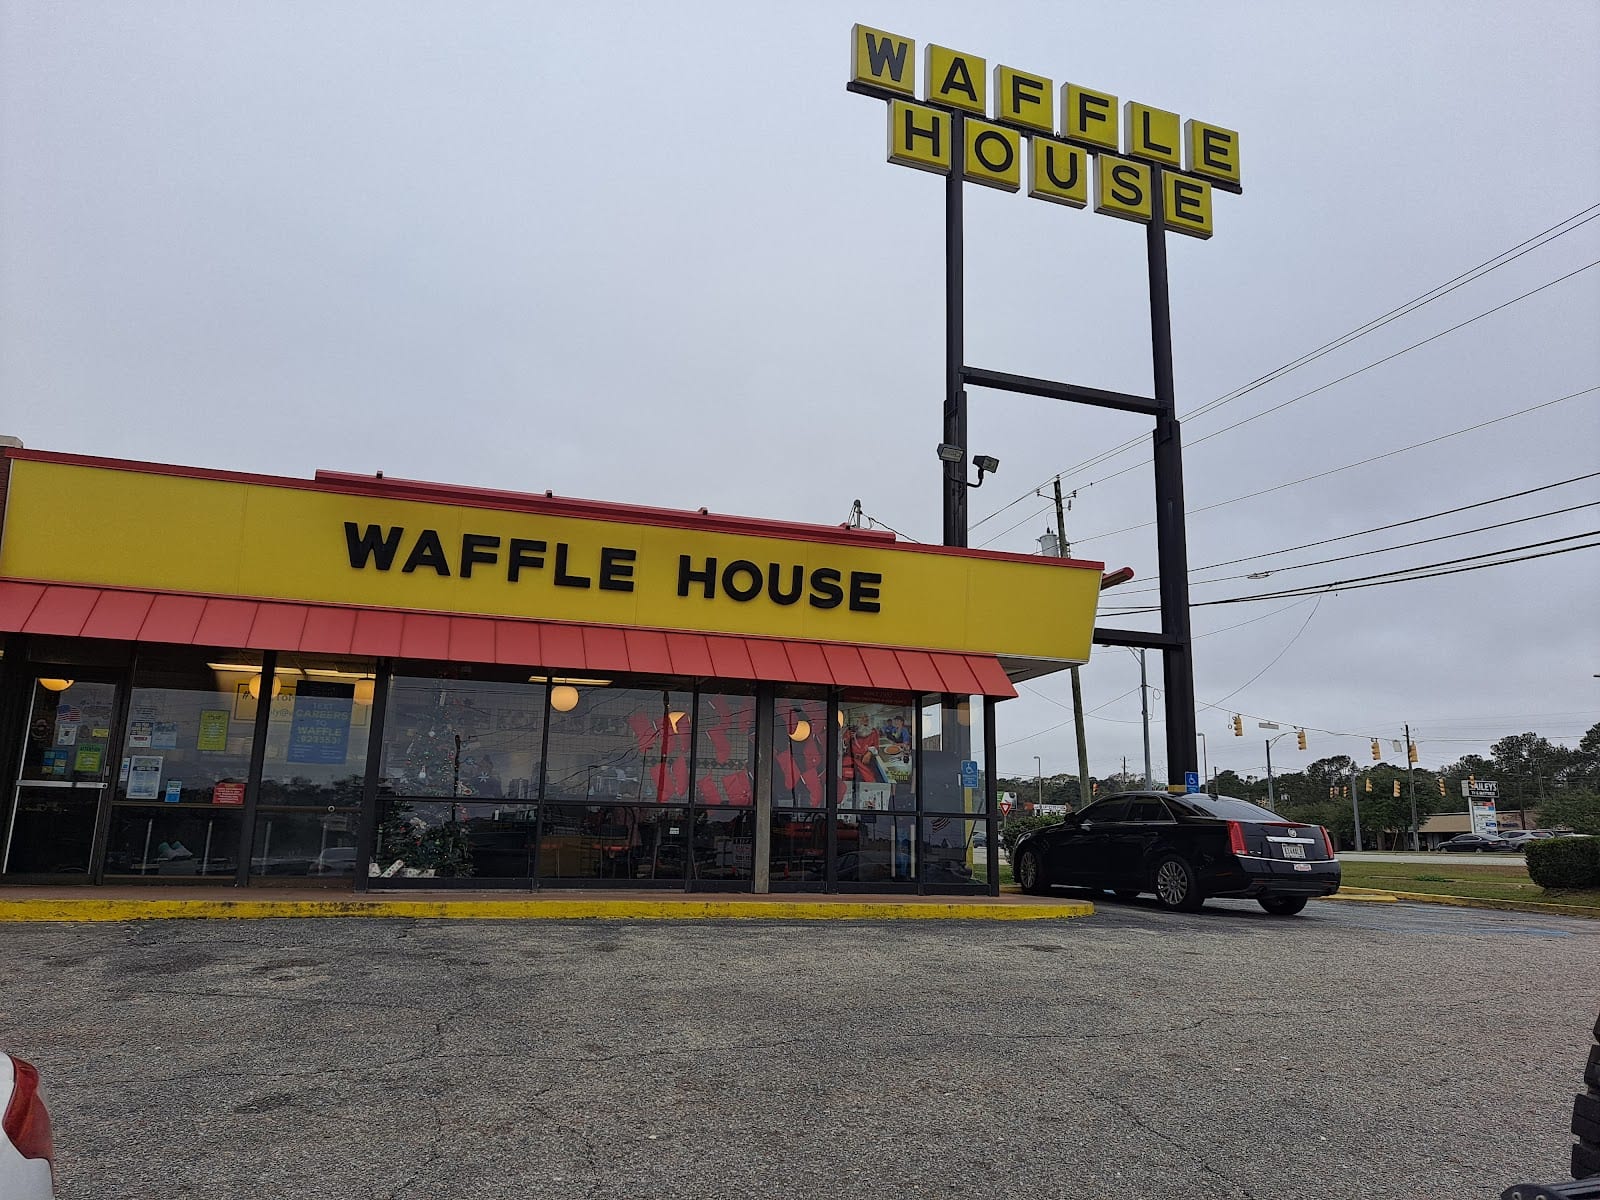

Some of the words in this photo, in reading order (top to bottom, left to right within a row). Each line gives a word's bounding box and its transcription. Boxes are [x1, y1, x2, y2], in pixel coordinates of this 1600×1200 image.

[865, 32, 1233, 172] WAFFLE
[904, 109, 1205, 224] HOUSE
[343, 521, 637, 593] WAFFLE
[677, 554, 883, 613] HOUSE
[296, 709, 349, 720] CAREERS
[297, 727, 342, 737] WAFFLE
